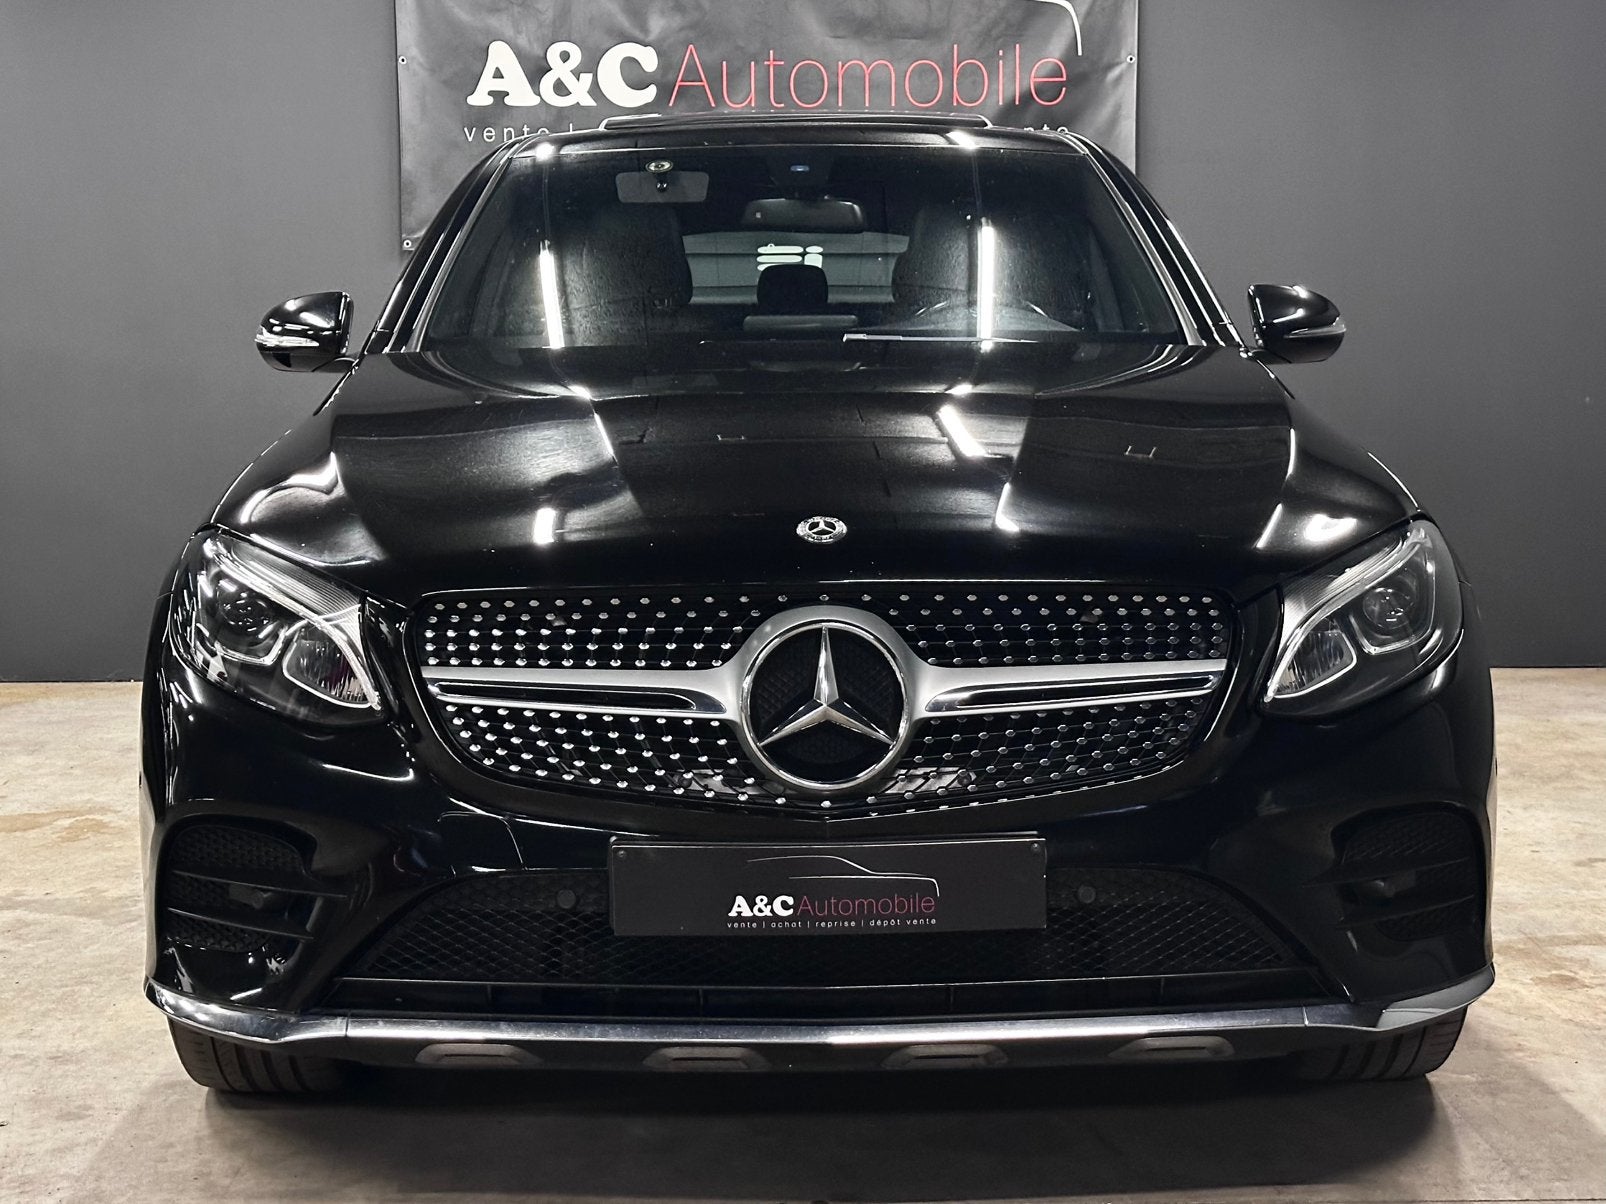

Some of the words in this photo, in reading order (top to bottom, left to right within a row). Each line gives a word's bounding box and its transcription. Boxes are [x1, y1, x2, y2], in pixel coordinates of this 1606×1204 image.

[466, 40, 659, 108] A&C
[668, 43, 1067, 108] Automobile
[727, 895, 795, 917] A&C
[797, 892, 936, 916] Automobile
[770, 920, 802, 928] achat
[815, 920, 856, 928] reprise
[906, 918, 936, 926] vente
